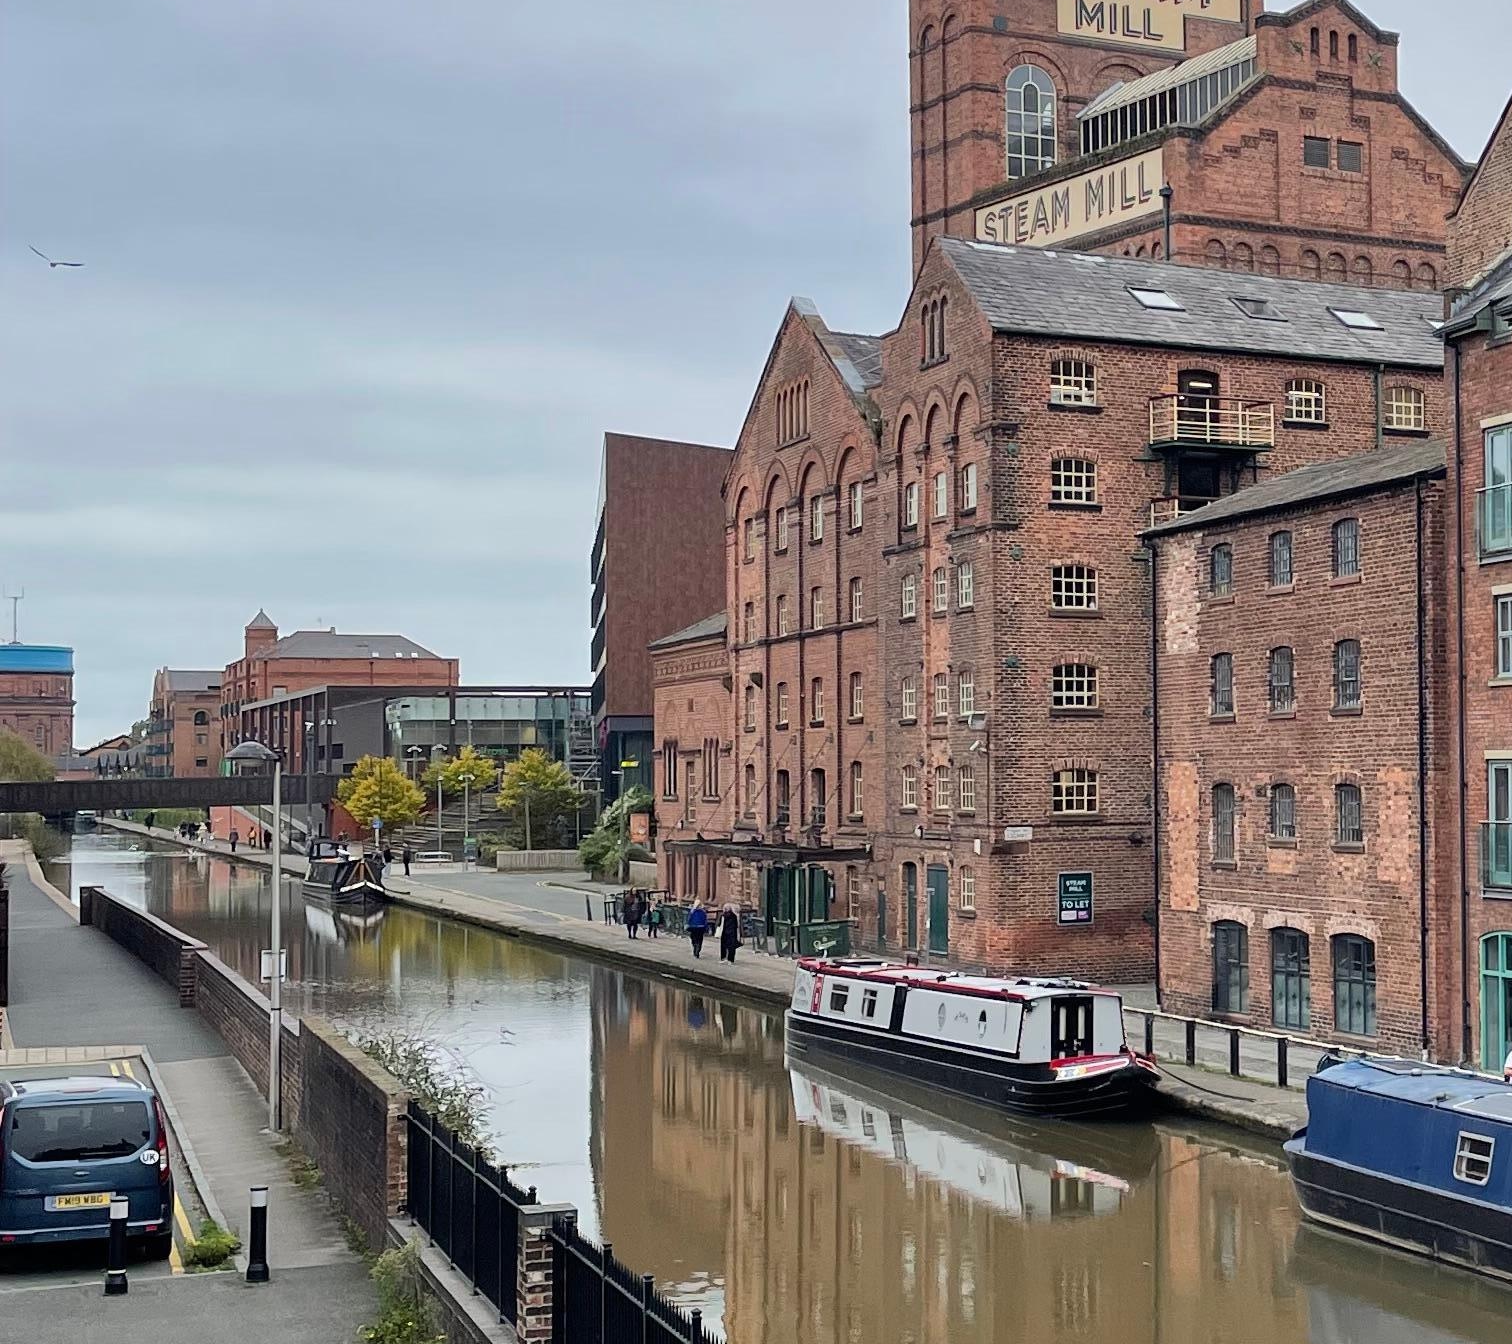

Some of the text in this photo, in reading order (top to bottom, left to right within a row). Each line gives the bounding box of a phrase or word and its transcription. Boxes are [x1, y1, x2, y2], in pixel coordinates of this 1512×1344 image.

[984, 160, 1153, 244] STEAM MILL
[1065, 879, 1087, 887] STEAM
[1062, 899, 1090, 908] TO LET
[142, 1154, 156, 1162] UK
